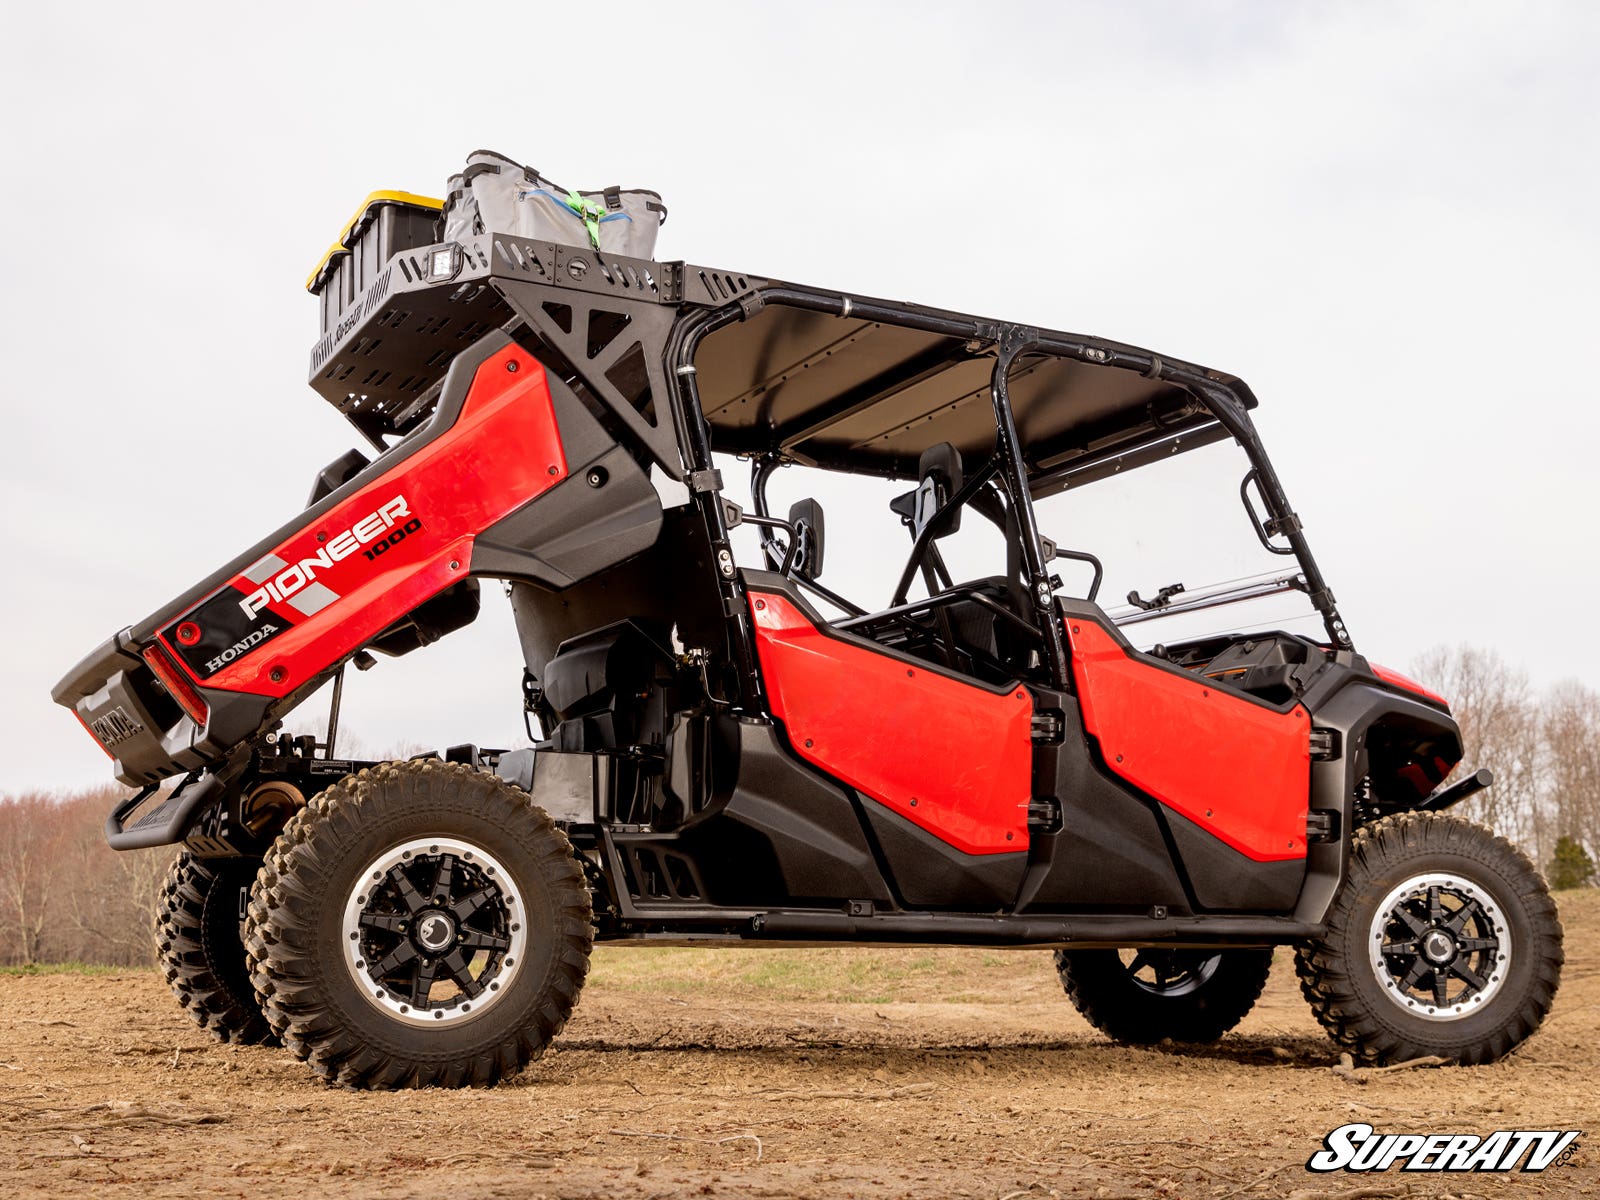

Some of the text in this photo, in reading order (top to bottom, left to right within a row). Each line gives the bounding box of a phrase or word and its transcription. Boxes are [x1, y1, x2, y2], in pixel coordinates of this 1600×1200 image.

[239, 495, 411, 621] PIONEER
[362, 518, 422, 561] 1000
[205, 623, 279, 673] HONDA
